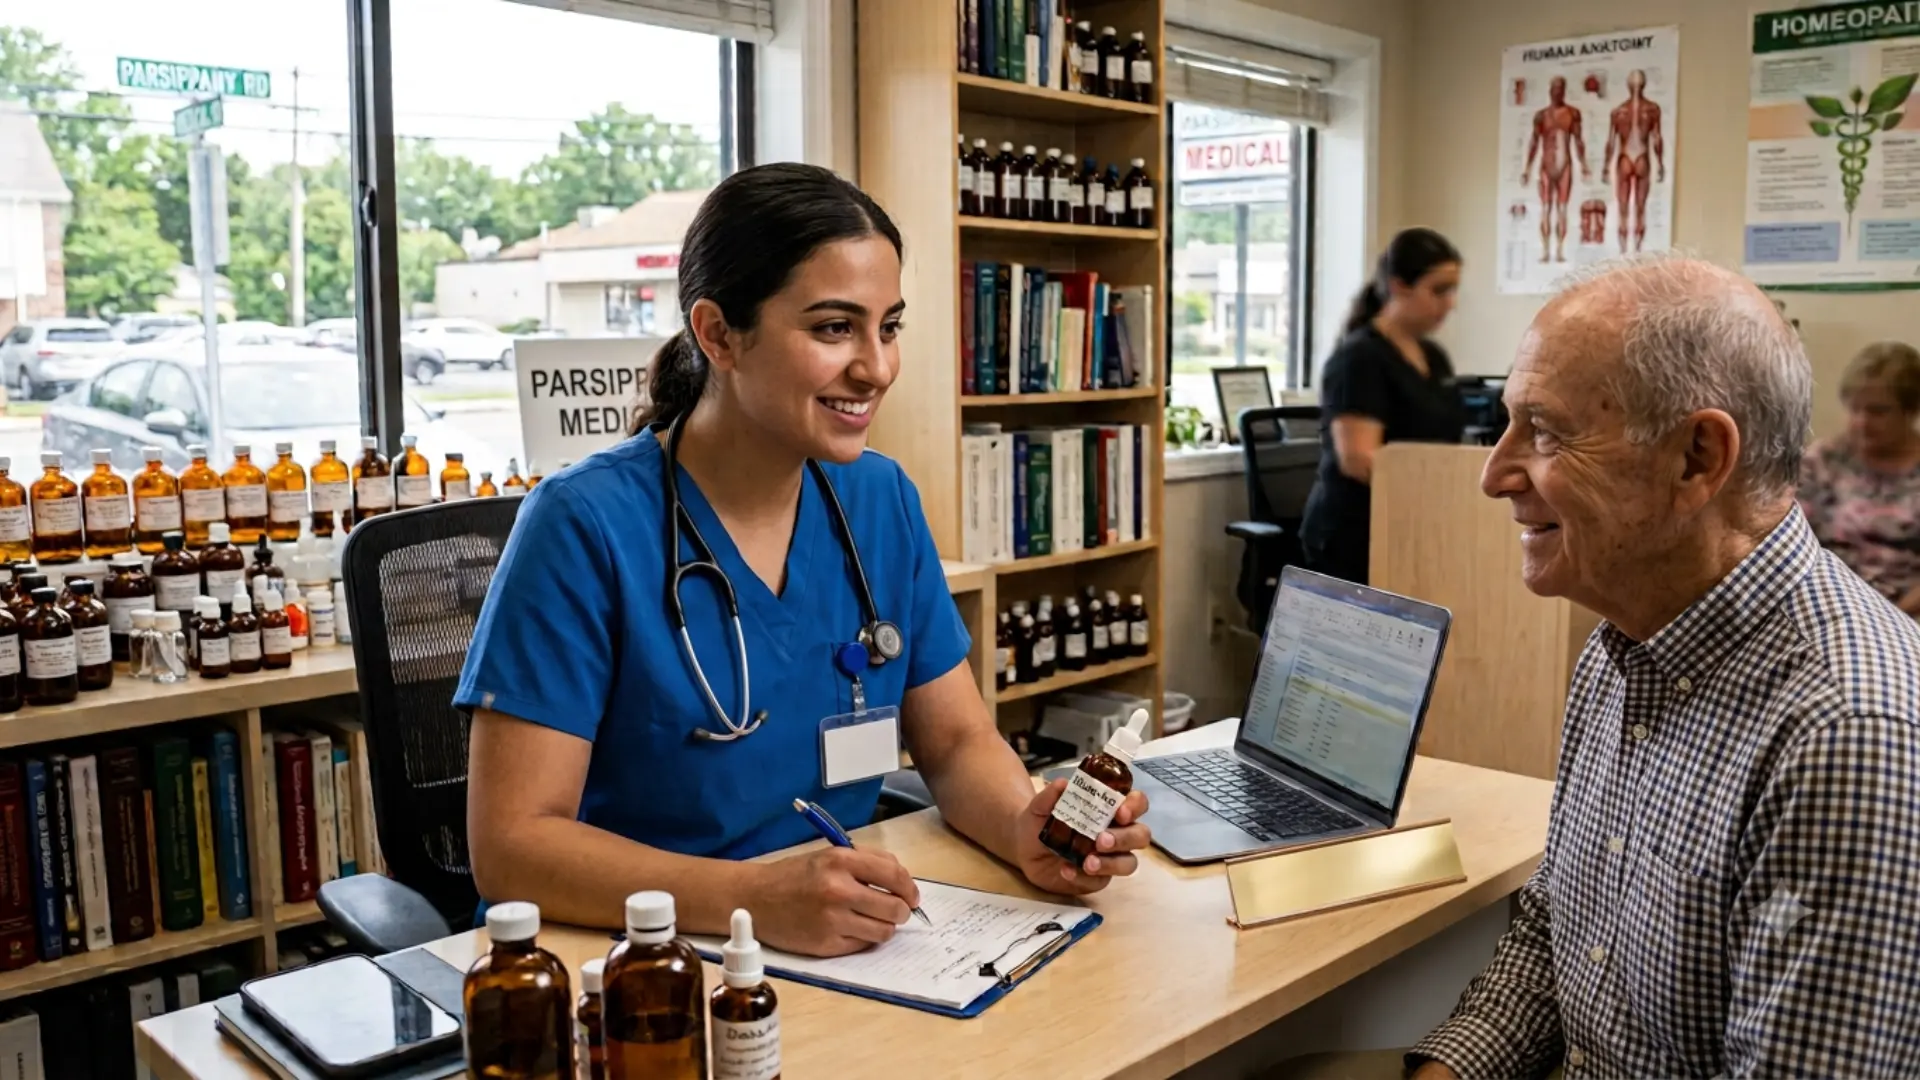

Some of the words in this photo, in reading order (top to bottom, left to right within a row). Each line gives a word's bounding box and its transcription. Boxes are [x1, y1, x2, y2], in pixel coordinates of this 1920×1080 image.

[243, 72, 270, 98] RD
[1186, 140, 1288, 171] MEDICAL
[531, 367, 648, 398] PARSIPP
[559, 405, 628, 437] MEDI
